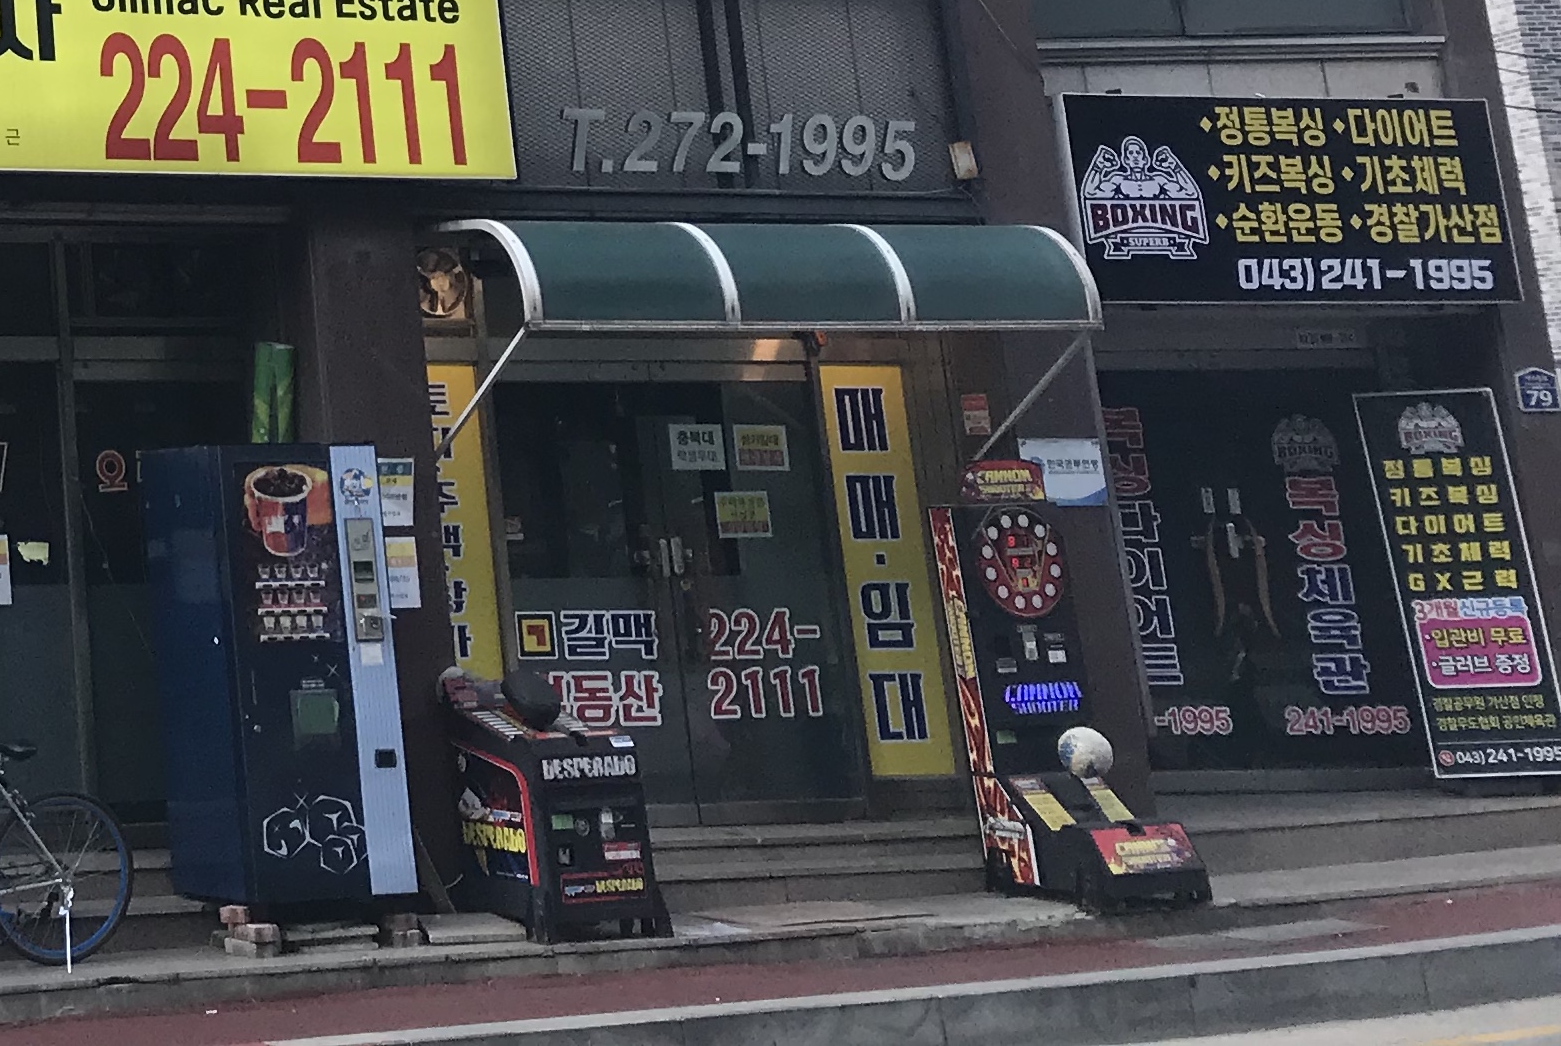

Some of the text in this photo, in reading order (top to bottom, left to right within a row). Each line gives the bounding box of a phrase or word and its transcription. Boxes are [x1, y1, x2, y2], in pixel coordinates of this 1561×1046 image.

[100, 32, 467, 165] 224-2111
[562, 108, 915, 181] T.272-1995
[1214, 107, 1458, 147] 정통복싱 다이어트
[1225, 154, 1466, 196] 키즈복싱 기초체력
[1091, 203, 1199, 235] BOXING
[1232, 204, 1503, 244] 순환운동 경찰가산점
[1129, 238, 1169, 246] SUPERB
[1526, 390, 1552, 406] 79
[1395, 513, 1505, 535] 다이어트
[560, 610, 658, 659] 길맥
[1431, 627, 1527, 648] 입관비 무료
[1439, 653, 1531, 675] 글러브 증정
[549, 671, 663, 726] 동산
[707, 665, 823, 719] 2111
[1285, 705, 1411, 736] 241-1995
[542, 755, 635, 780] DESPERADO
